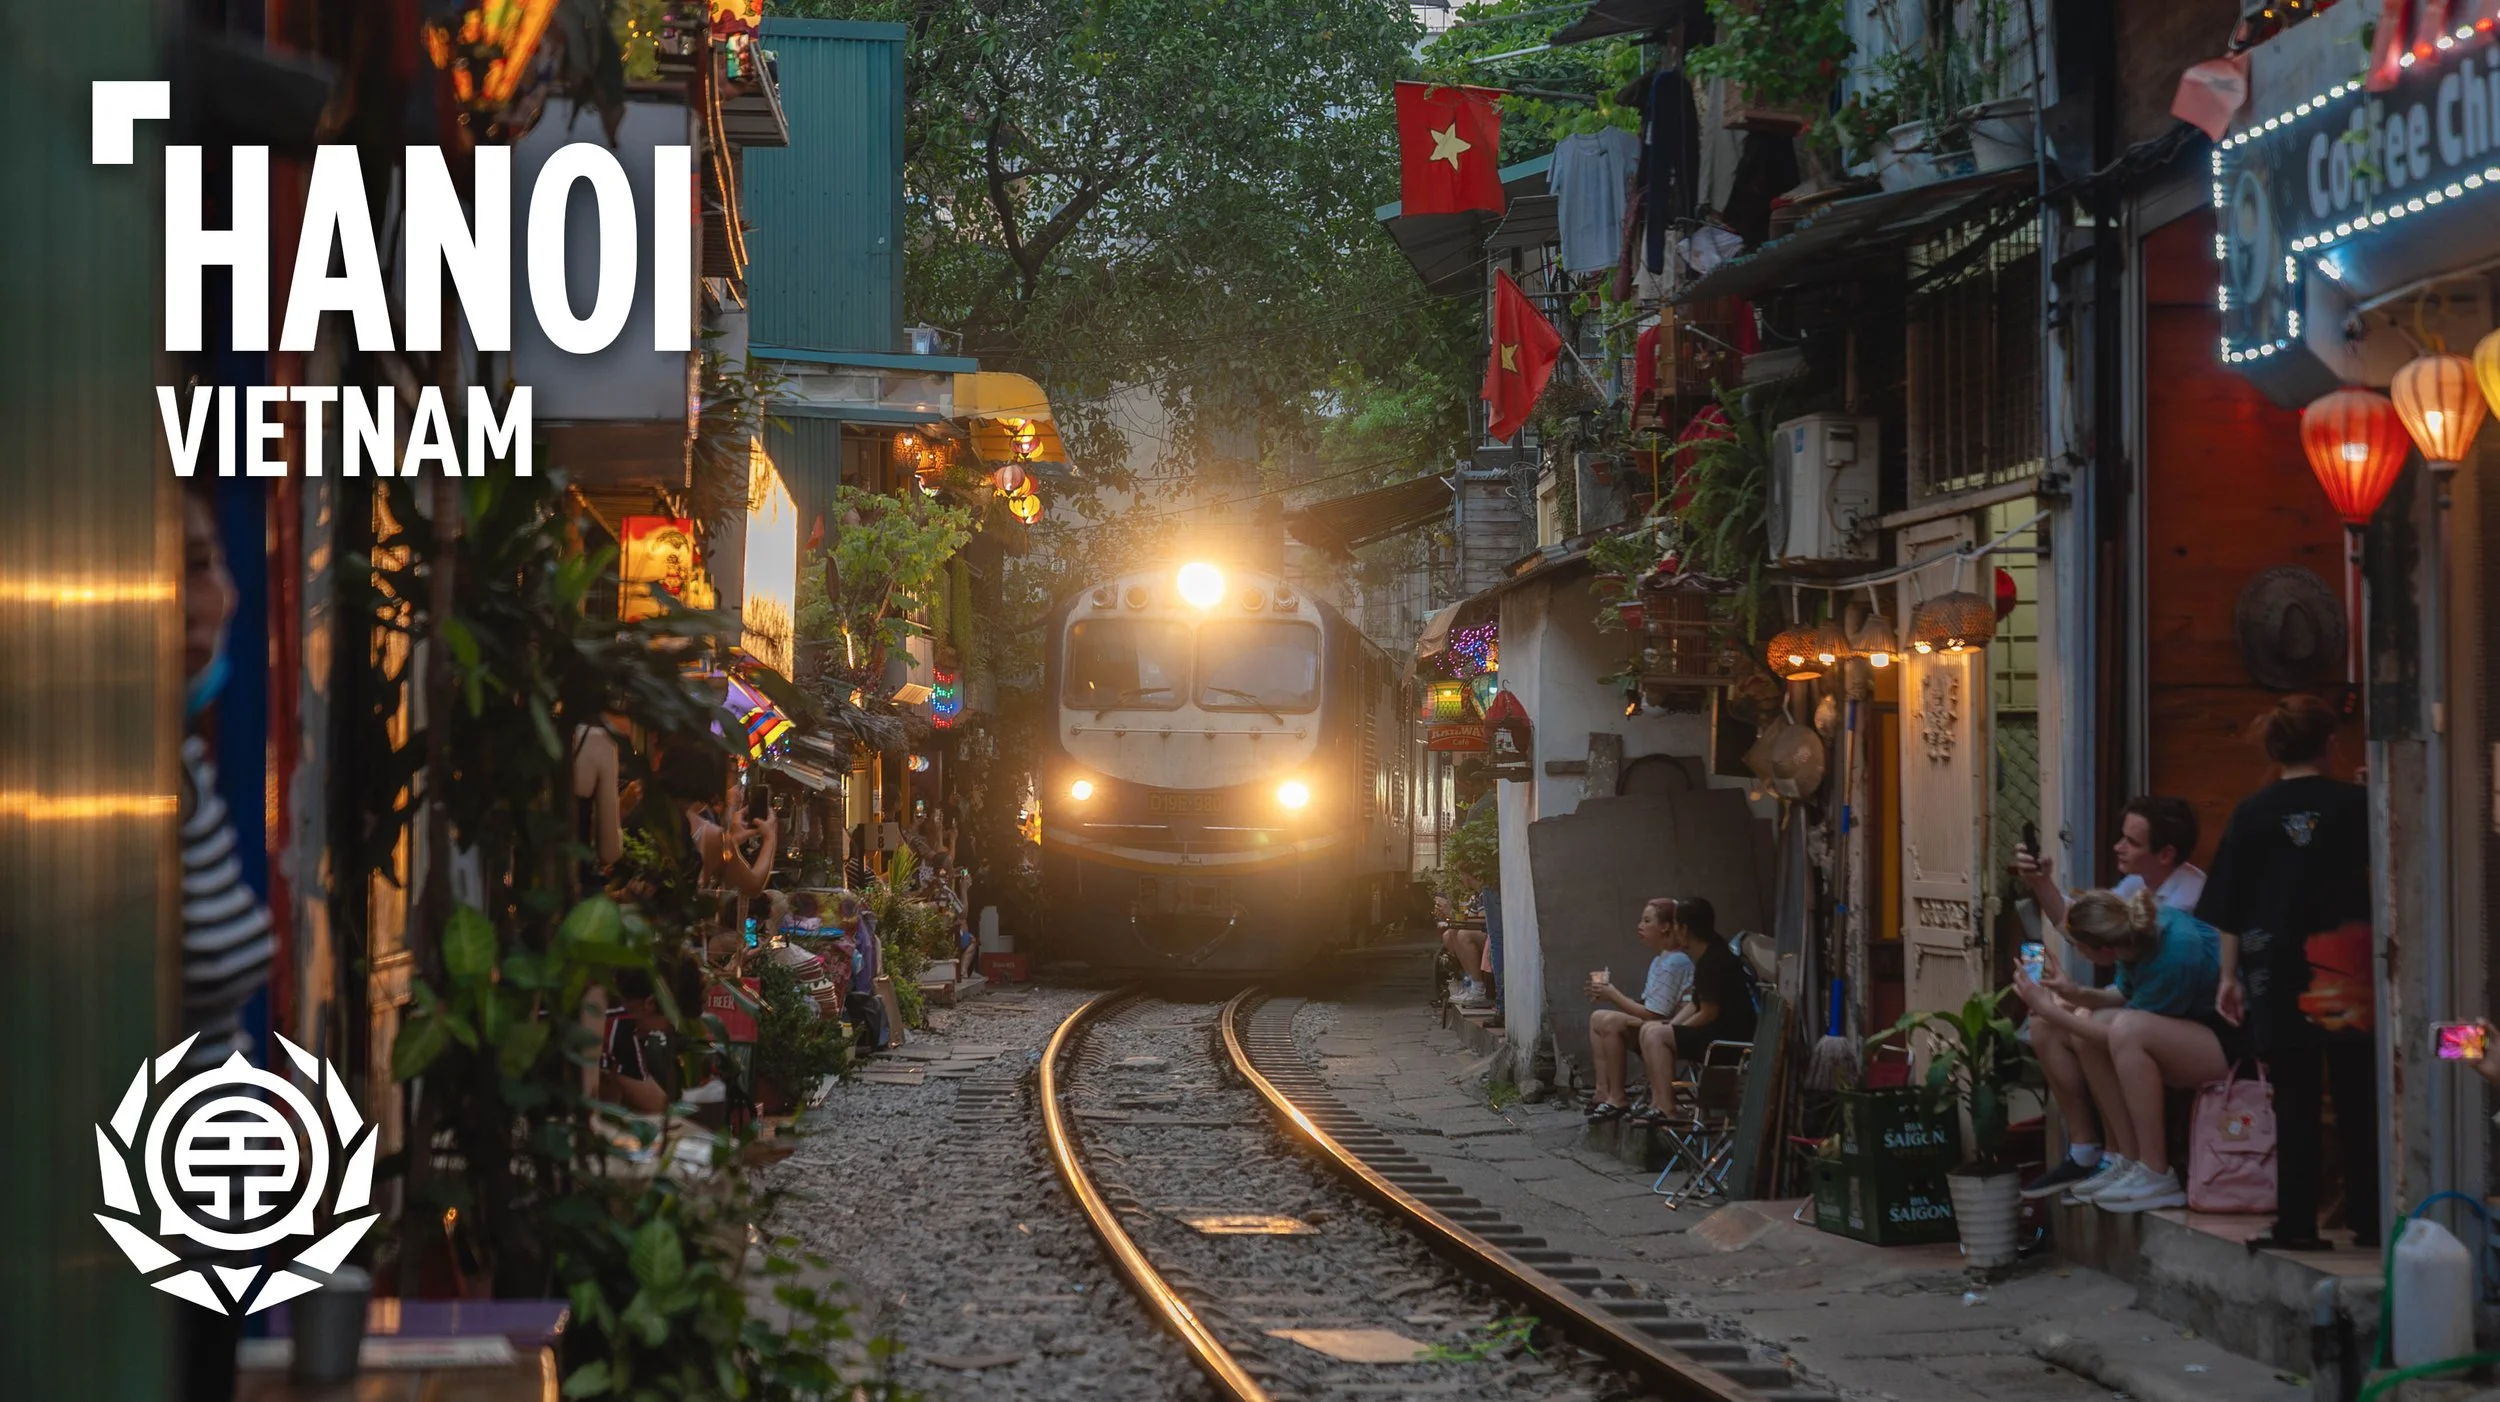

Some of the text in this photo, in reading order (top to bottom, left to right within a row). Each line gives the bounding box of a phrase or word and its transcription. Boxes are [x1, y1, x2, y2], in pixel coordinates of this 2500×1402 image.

[2308, 100, 2431, 219] Coffee
[1884, 1129, 1945, 1148] SAIGON
[1889, 1204, 1952, 1222] SAIGON
